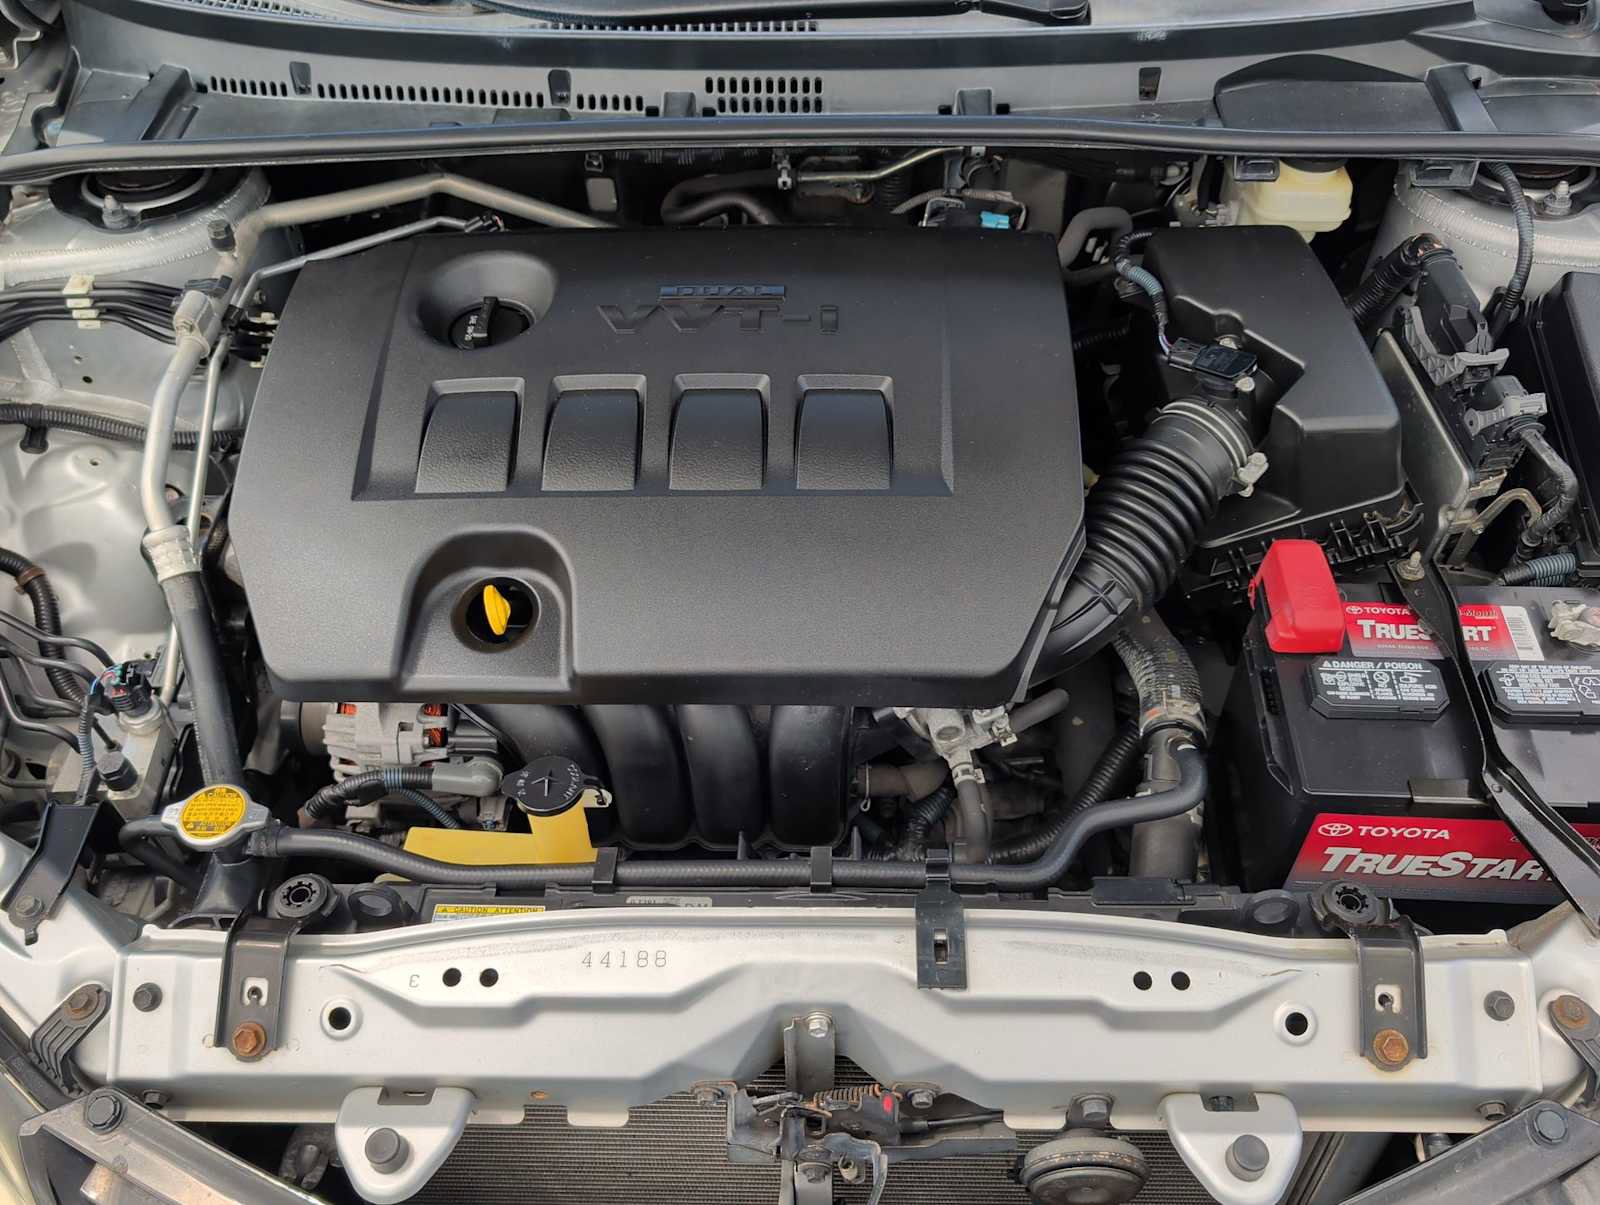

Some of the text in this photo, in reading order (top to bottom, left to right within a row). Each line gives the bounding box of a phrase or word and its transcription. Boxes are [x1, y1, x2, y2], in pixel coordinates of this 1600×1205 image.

[677, 286, 773, 296] DUAL
[1364, 606, 1411, 616] TOYOTA
[1332, 660, 1374, 669] DANGER
[1384, 662, 1423, 670] POISON
[1358, 825, 1450, 840] TOYOTA
[1320, 847, 1553, 881] TRUESTAR
[582, 950, 668, 968] 44188
